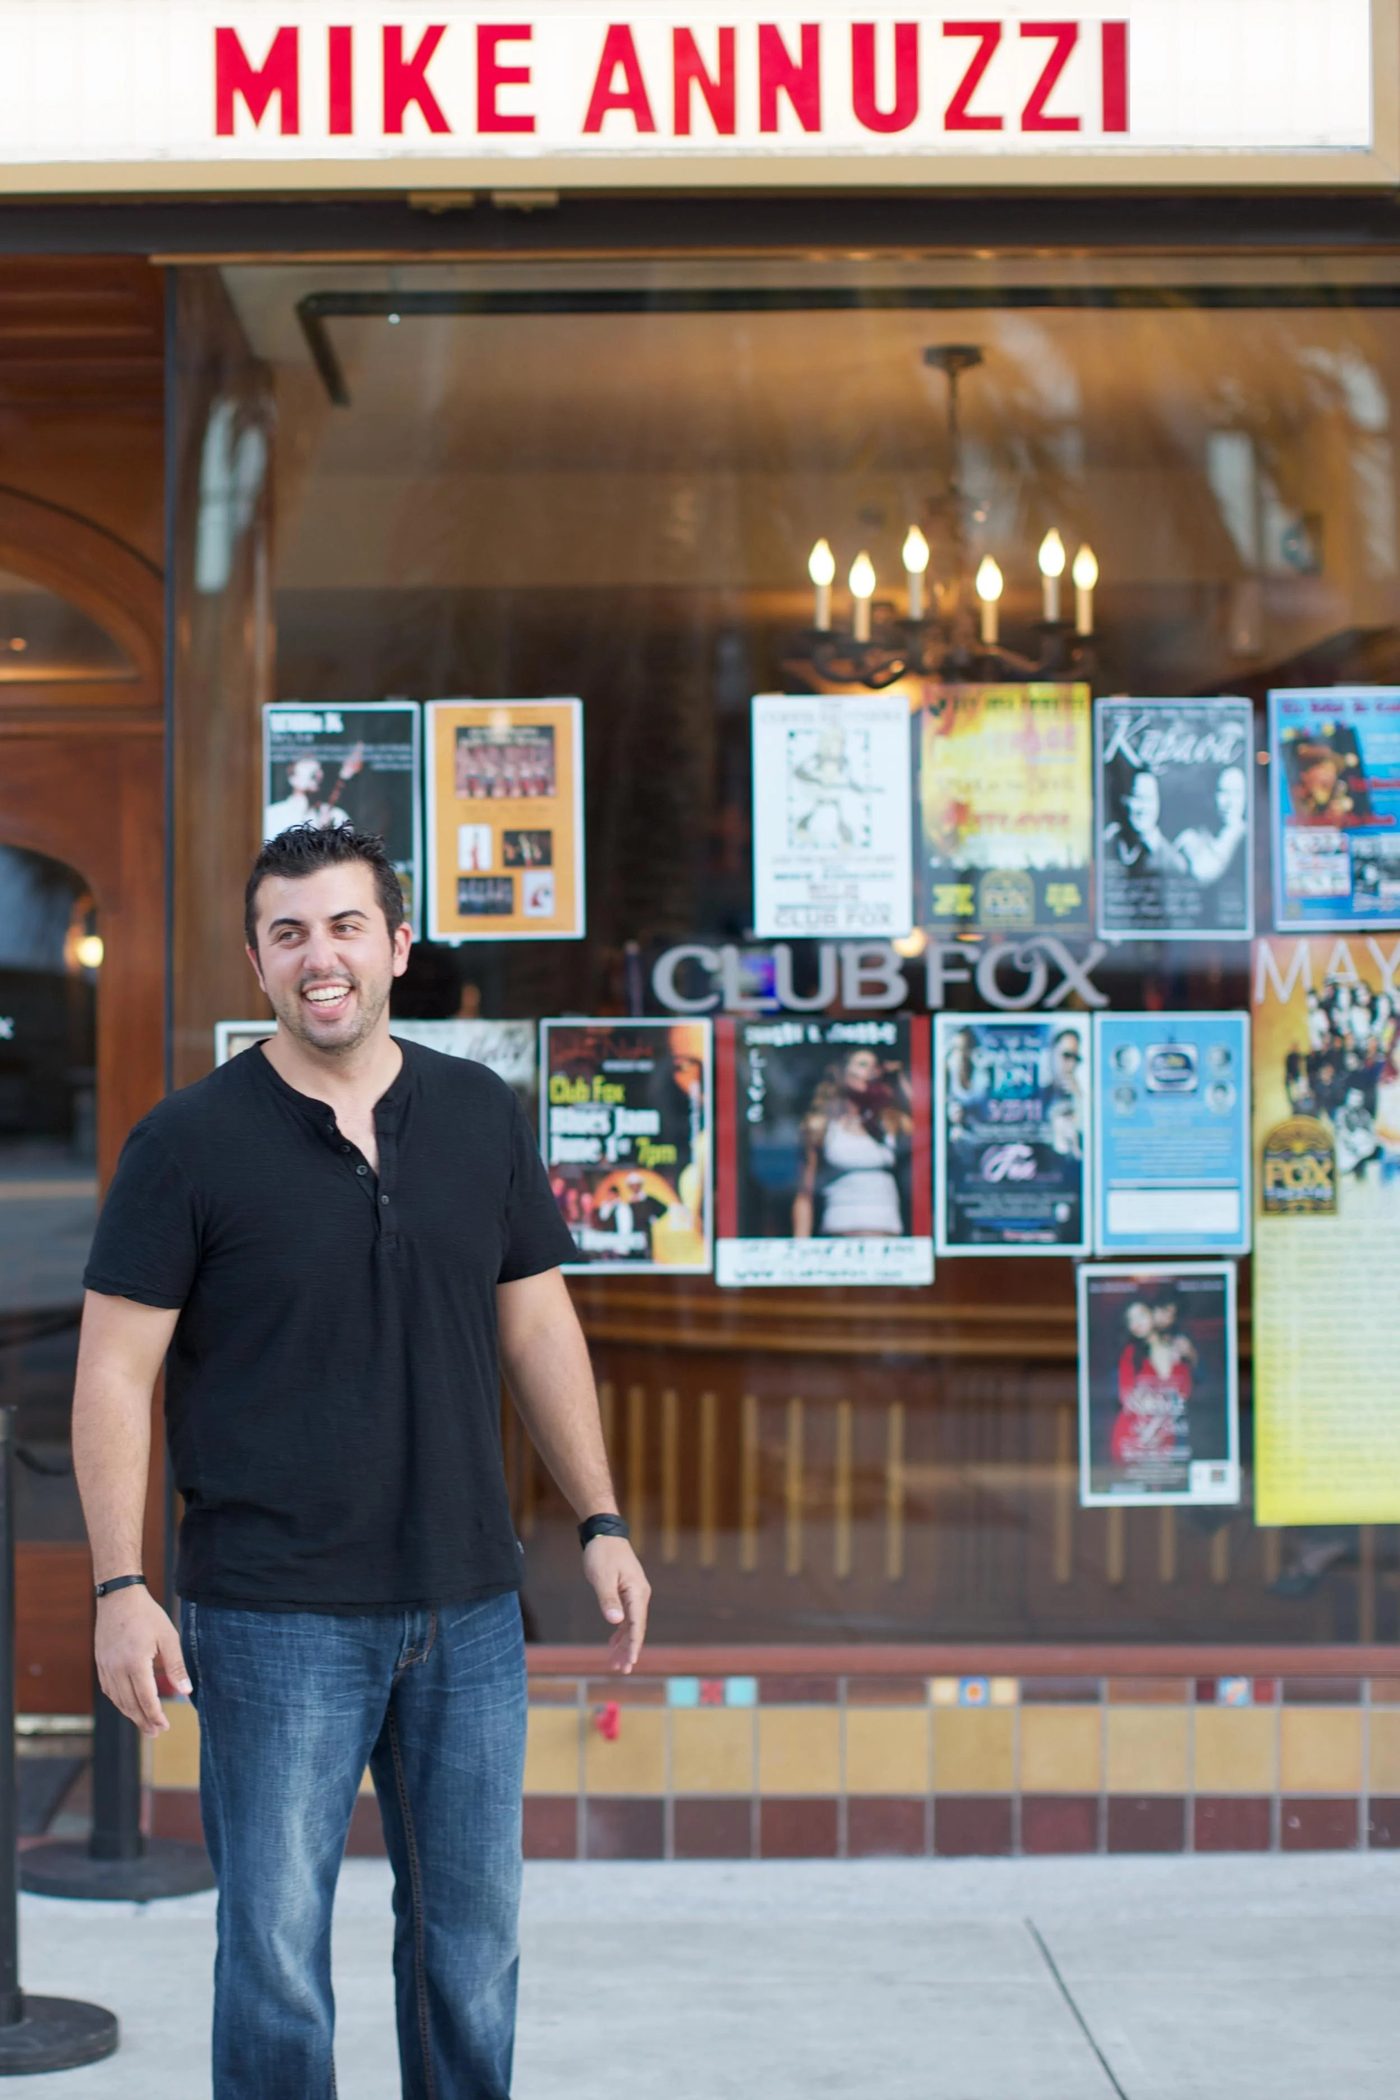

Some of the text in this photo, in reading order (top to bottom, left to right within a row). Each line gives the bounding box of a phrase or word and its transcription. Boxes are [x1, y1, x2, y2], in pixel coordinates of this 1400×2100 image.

[213, 18, 1131, 136] MIKE ANNUZZI
[652, 937, 1110, 1012] CLUB FOX
[1254, 937, 1400, 1005] MAY
[550, 1075, 625, 1104] Club Fox
[550, 1136, 602, 1165] June
[635, 1137, 678, 1169] 7pm
[1264, 1156, 1334, 1190] FOX
